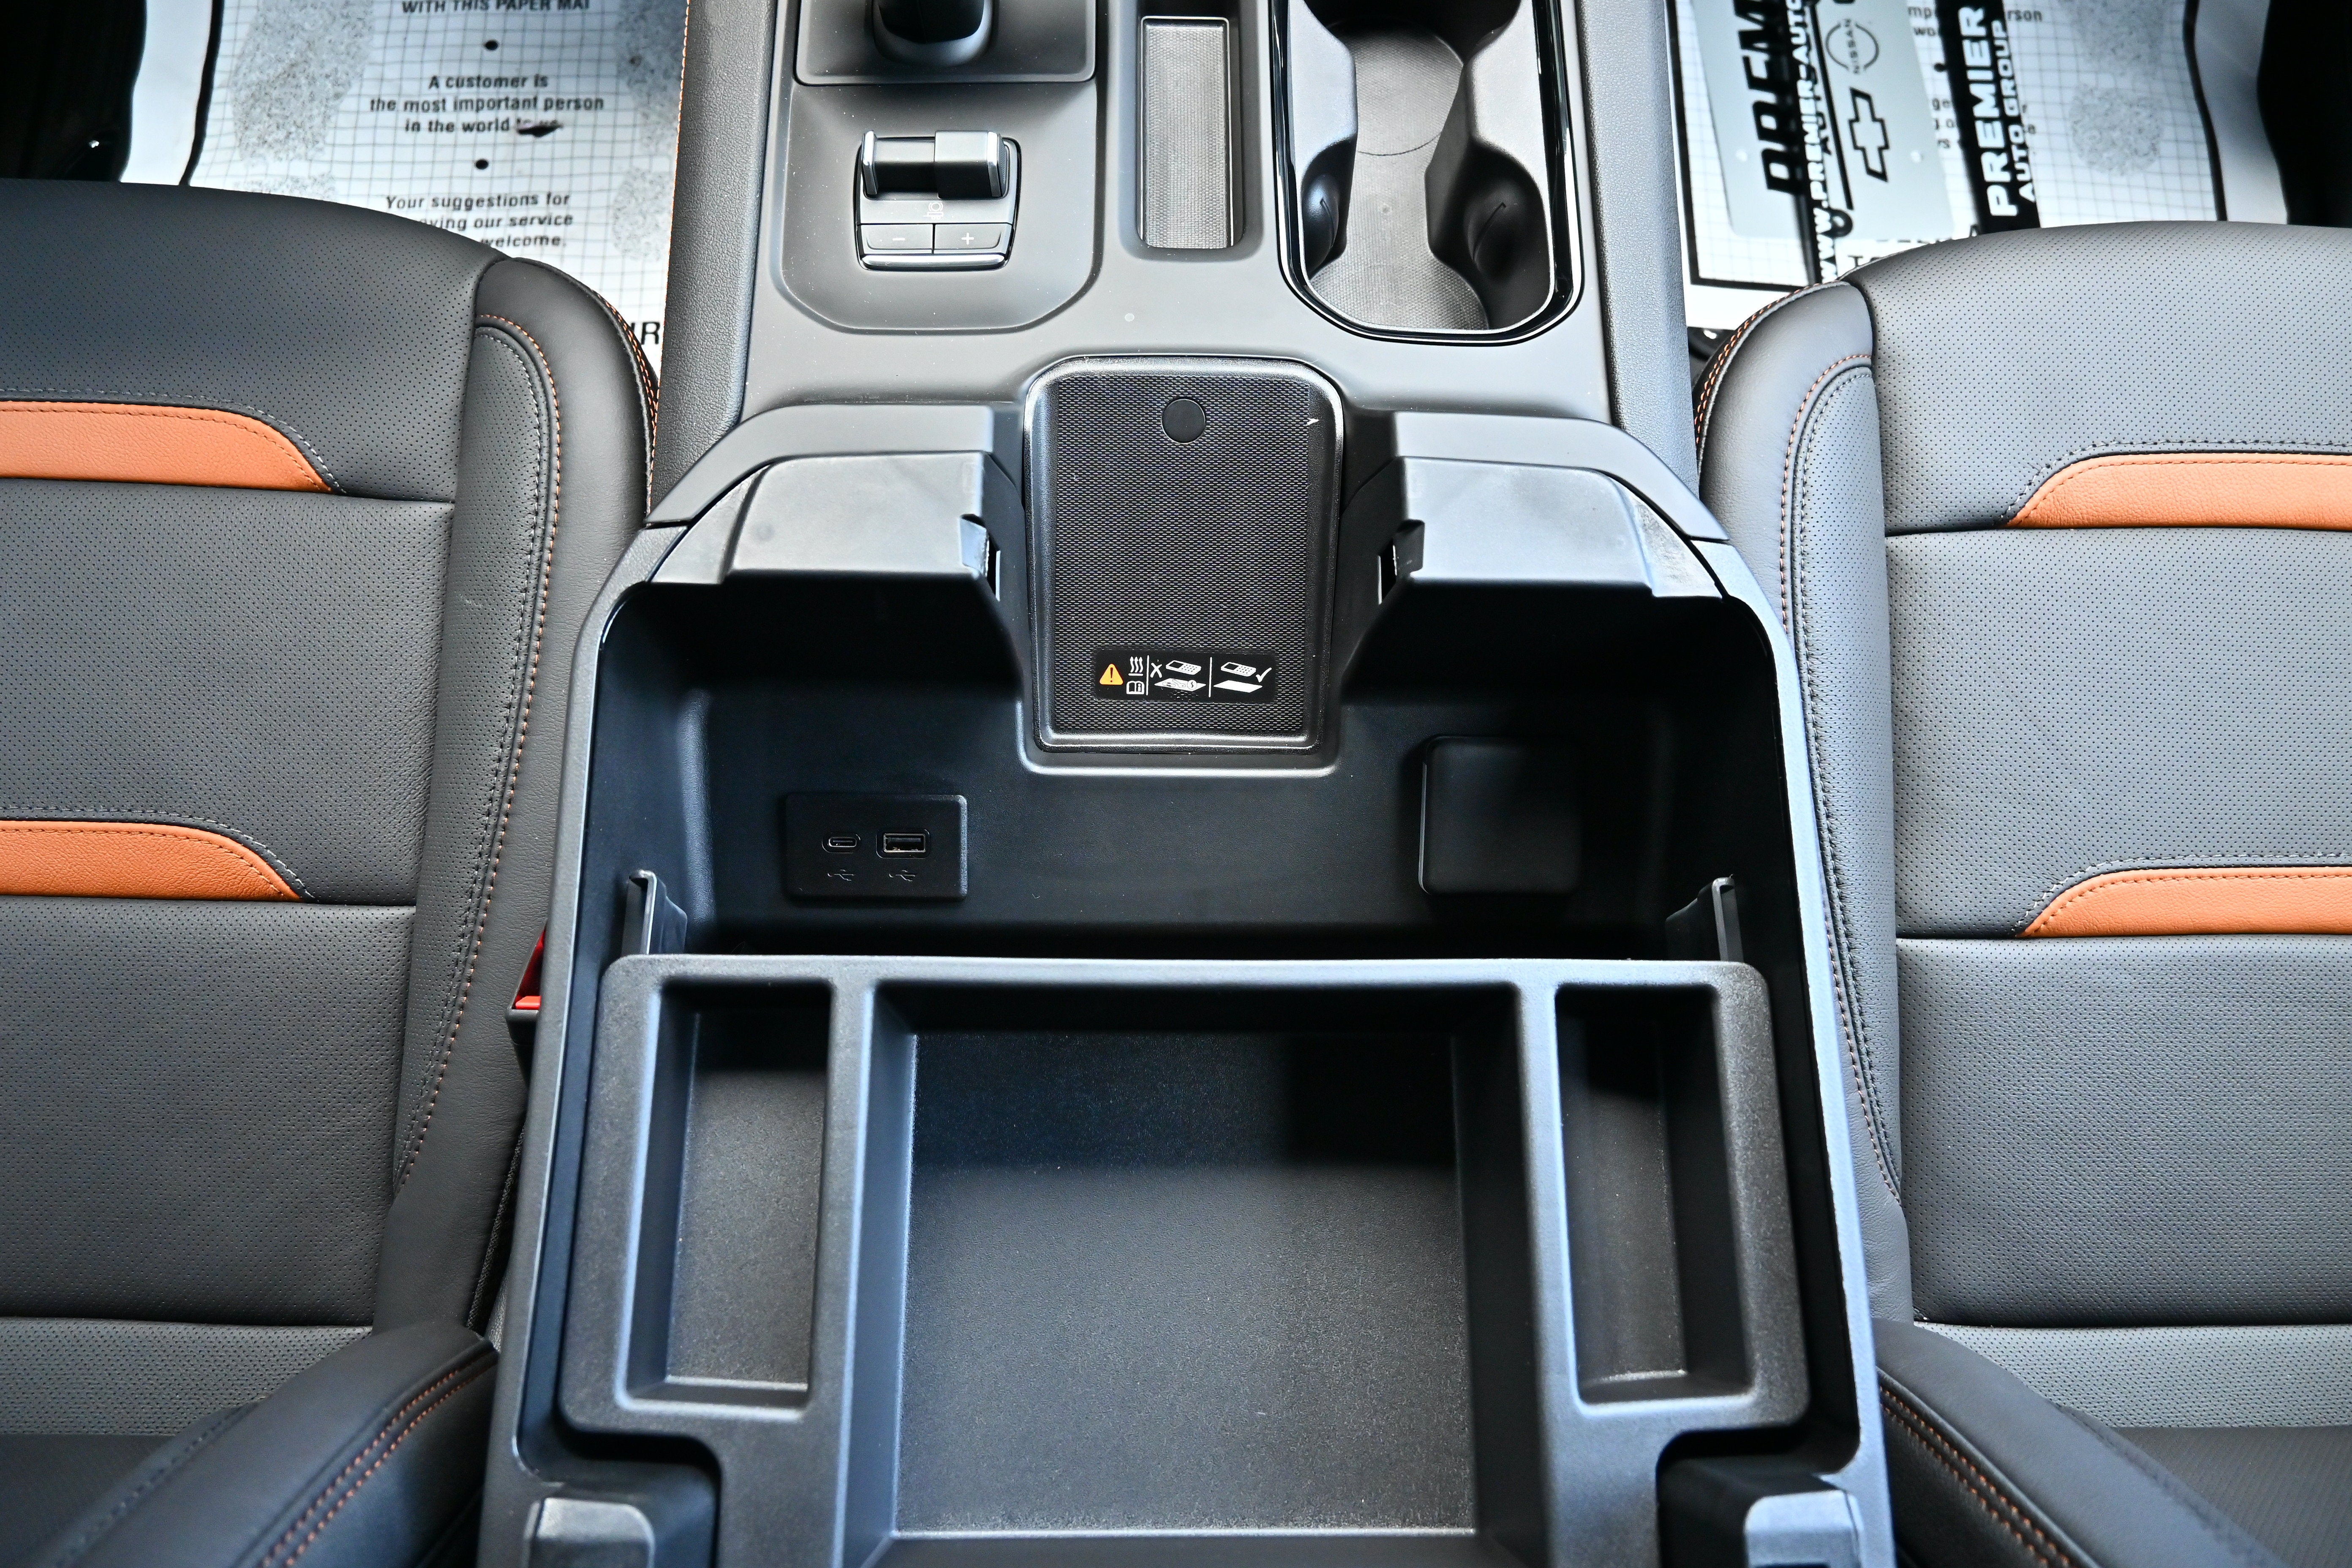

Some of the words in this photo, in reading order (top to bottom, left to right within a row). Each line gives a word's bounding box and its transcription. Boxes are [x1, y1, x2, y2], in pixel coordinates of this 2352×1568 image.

[402, 0, 446, 13] WITH
[453, 0, 489, 11] THIS
[495, 0, 550, 11] PAPER
[1844, 18, 1860, 74] NISSAN
[1991, 19, 2020, 117] GROUP
[429, 76, 439, 89] A
[445, 75, 527, 88] customer
[534, 74, 548, 88] is
[370, 98, 396, 112] the
[403, 99, 446, 112] most
[453, 95, 538, 112] important
[544, 97, 604, 112] person
[1957, 6, 2018, 217] PREMIER
[405, 118, 420, 132] in
[428, 119, 455, 132] the
[461, 117, 510, 132] world
[2007, 124, 2036, 203] AUTO
[386, 196, 425, 209] Your
[431, 193, 539, 211] suggestions
[546, 191, 570, 205] for
[474, 218, 503, 229] our
[509, 213, 573, 228] service
